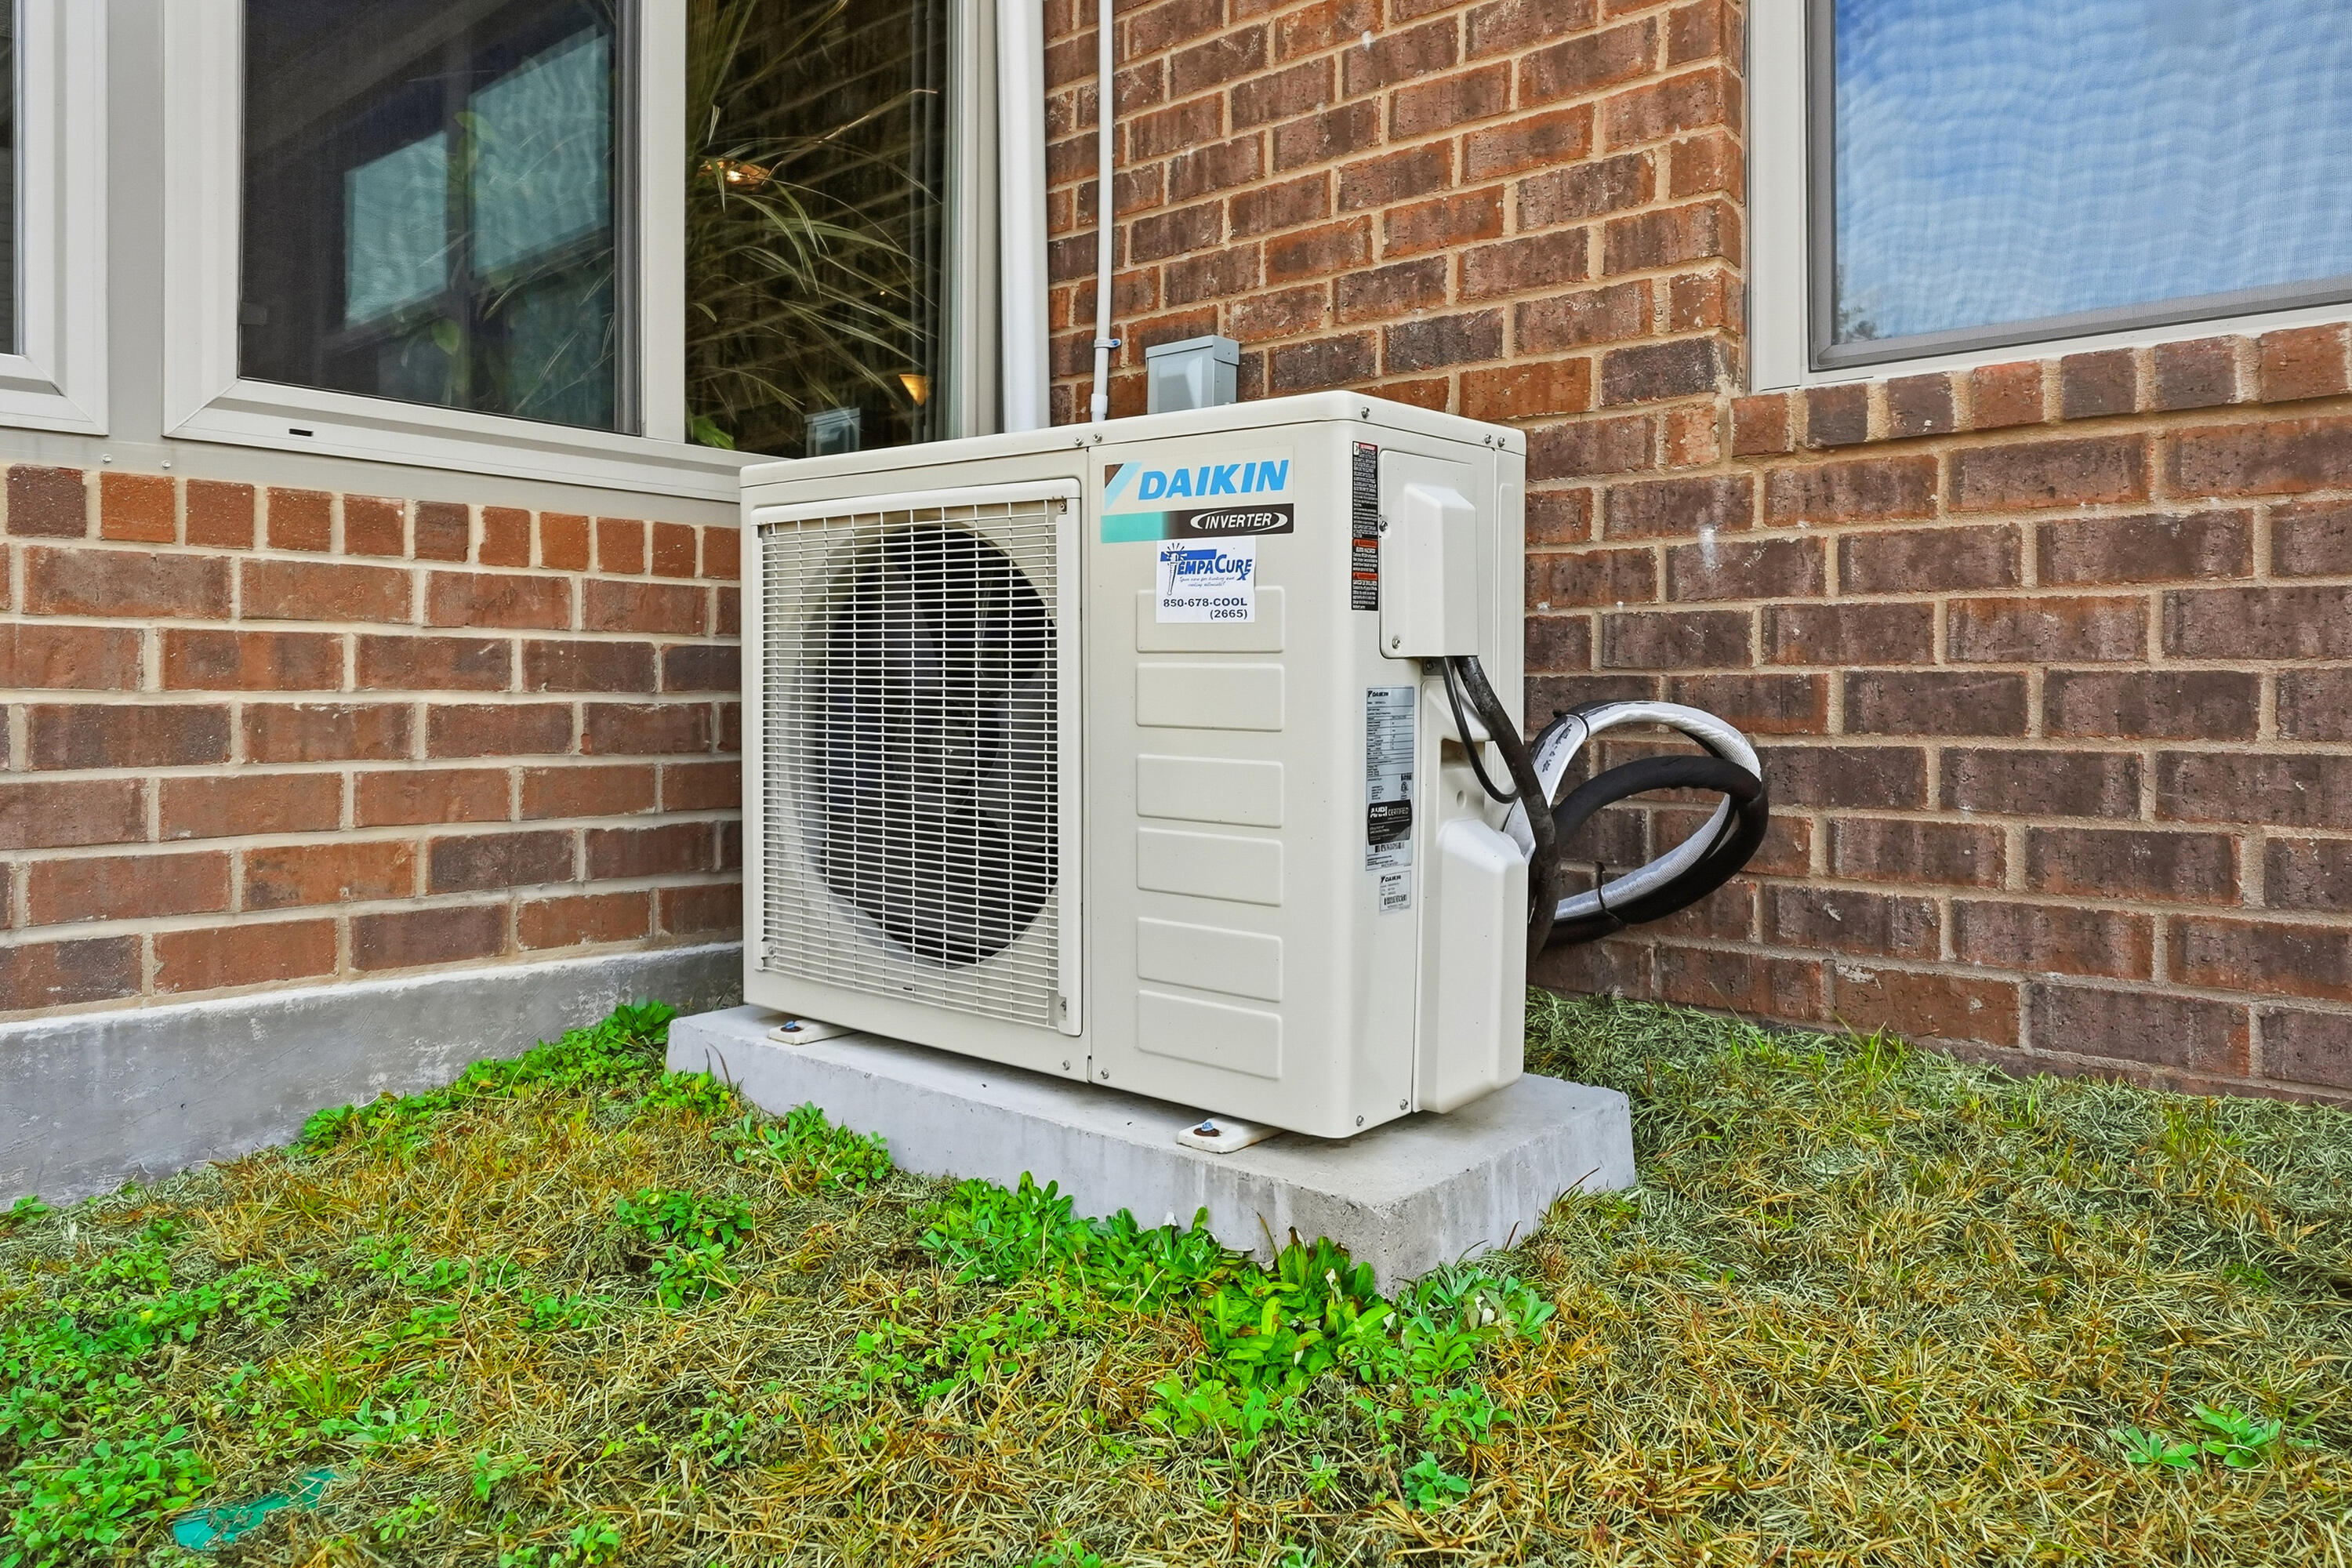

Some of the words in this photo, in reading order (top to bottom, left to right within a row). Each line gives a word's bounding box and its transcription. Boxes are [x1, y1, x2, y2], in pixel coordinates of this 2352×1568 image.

[1138, 459, 1290, 500] DAIKIN
[1205, 513, 1272, 530] INVERTER
[1210, 609, 1248, 620] (2665)
